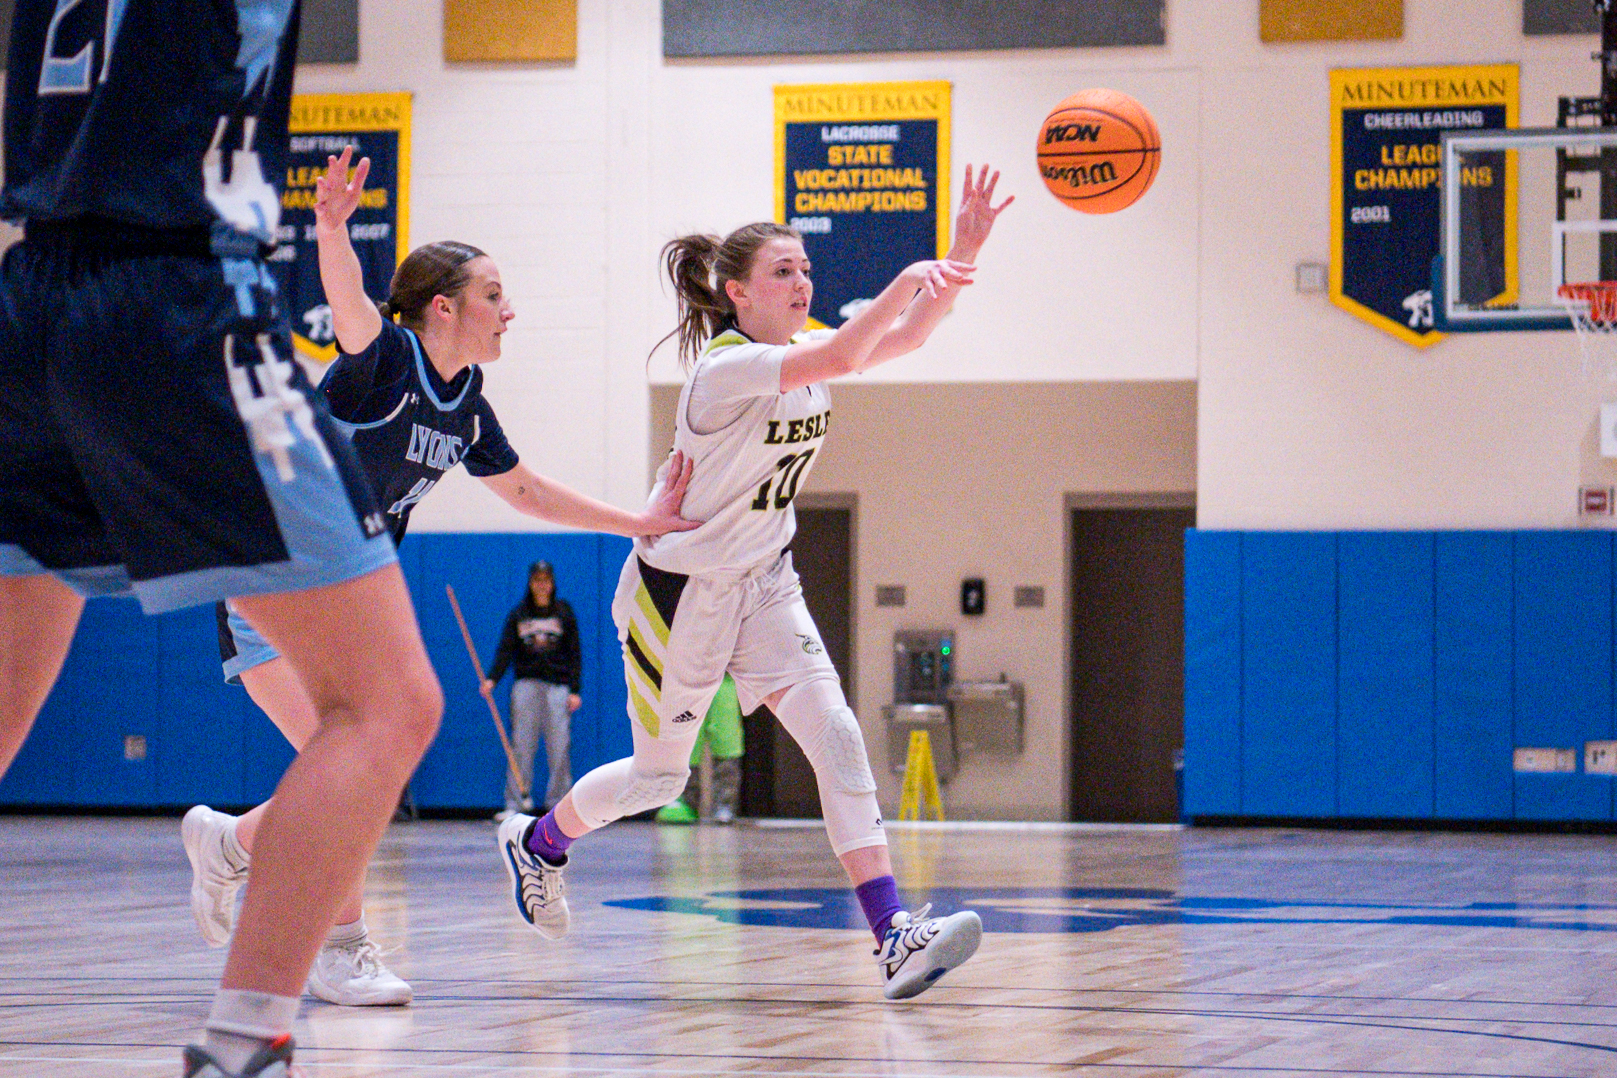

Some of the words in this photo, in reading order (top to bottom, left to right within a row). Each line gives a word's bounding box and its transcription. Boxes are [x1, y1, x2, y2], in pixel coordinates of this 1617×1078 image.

[1342, 79, 1506, 101] MINUTEMAN
[785, 94, 938, 114] MINUTEMAN
[1364, 110, 1484, 130] CHEERLEADING
[827, 144, 893, 166] STATE
[1381, 143, 1464, 166] LEAG
[793, 167, 928, 190] VOCATIONAL
[795, 190, 927, 213] CHAMPIONS
[1351, 205, 1391, 224] 2001
[405, 422, 463, 472] LYONS
[750, 446, 817, 511] 10
